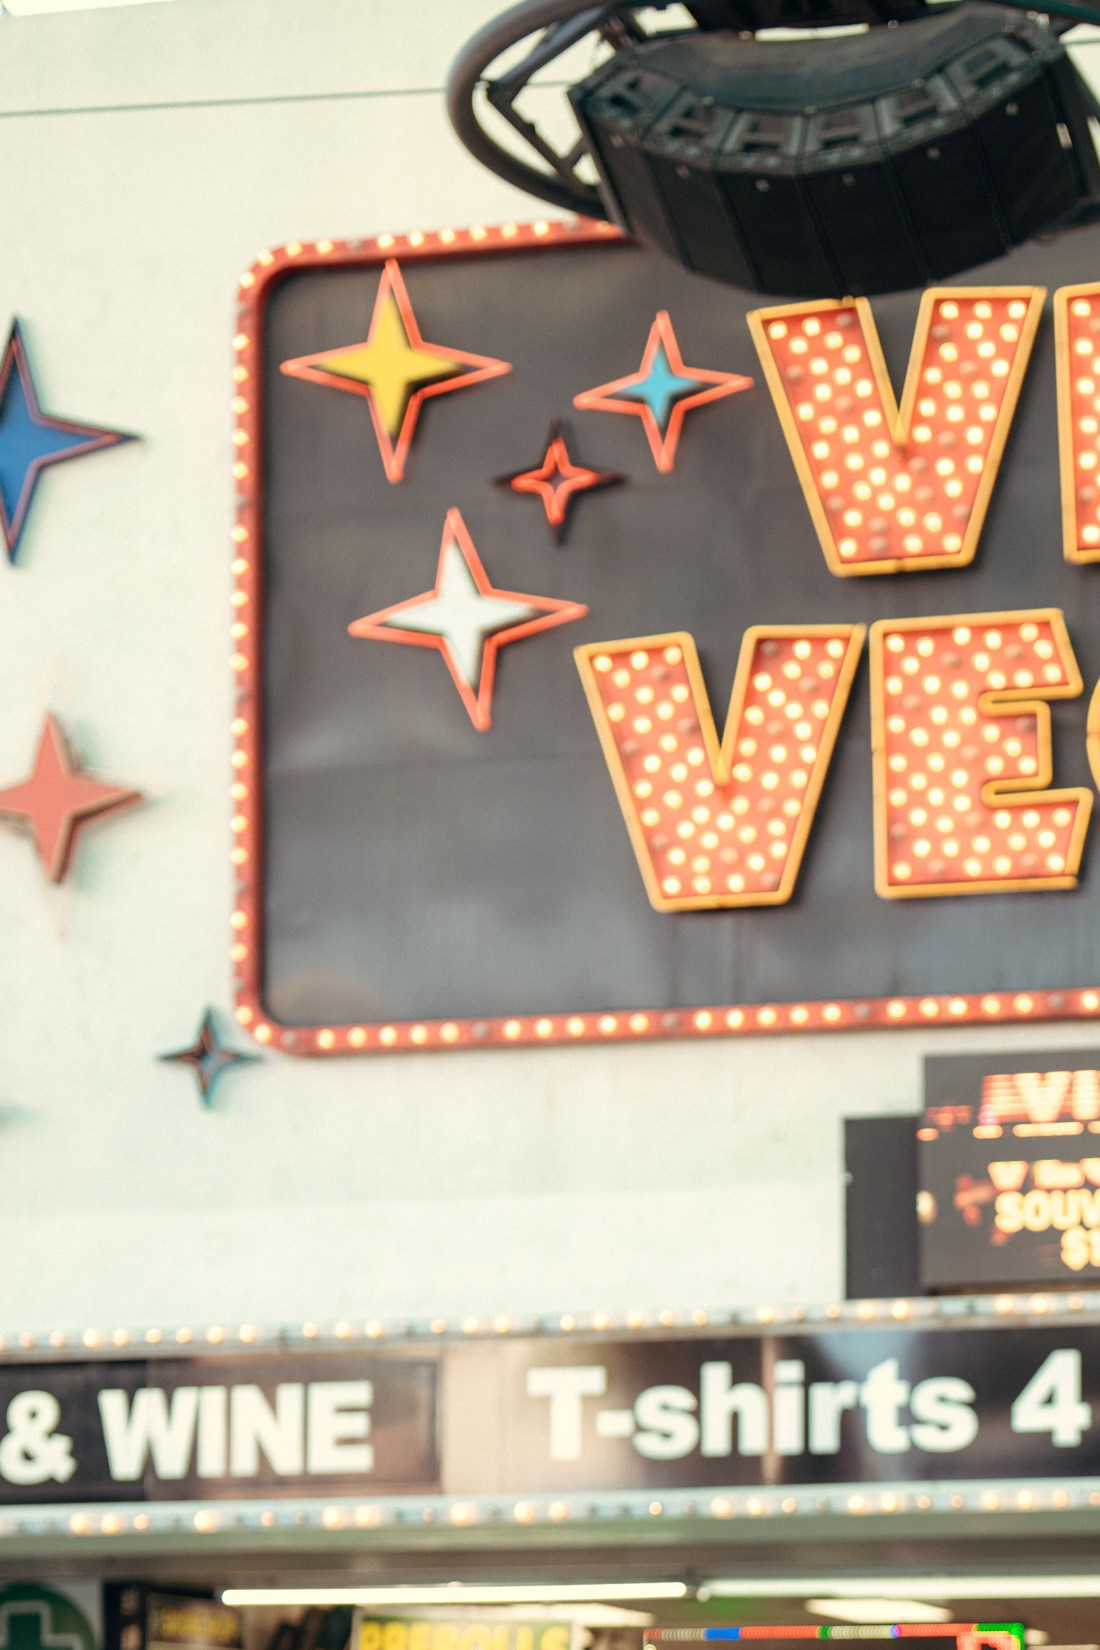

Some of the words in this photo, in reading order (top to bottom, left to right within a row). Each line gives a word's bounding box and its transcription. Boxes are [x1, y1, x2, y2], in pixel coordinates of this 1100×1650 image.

[0, 1389, 78, 1486] &
[98, 1380, 374, 1480] WINE
[526, 1358, 979, 1461] T-shirts
[1011, 1347, 1093, 1448] 4
